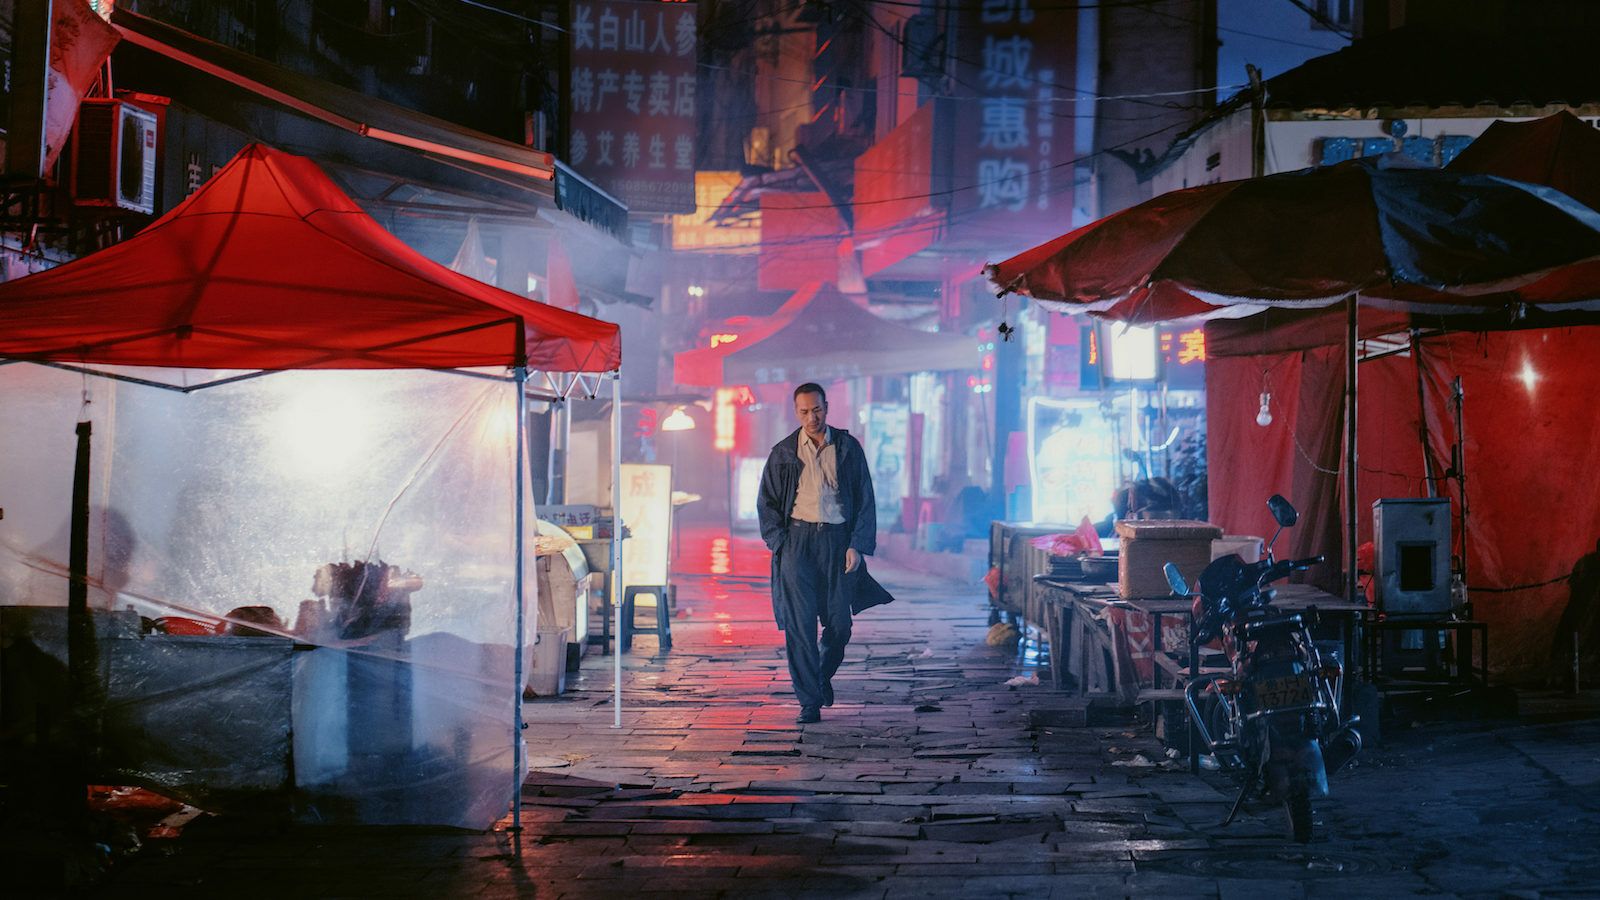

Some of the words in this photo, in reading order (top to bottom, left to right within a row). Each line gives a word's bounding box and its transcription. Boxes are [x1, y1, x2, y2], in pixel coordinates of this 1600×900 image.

[573, 6, 697, 57] 长白山人参
[571, 67, 697, 118] 特产专卖店
[570, 130, 693, 170] 参艾养生堂
